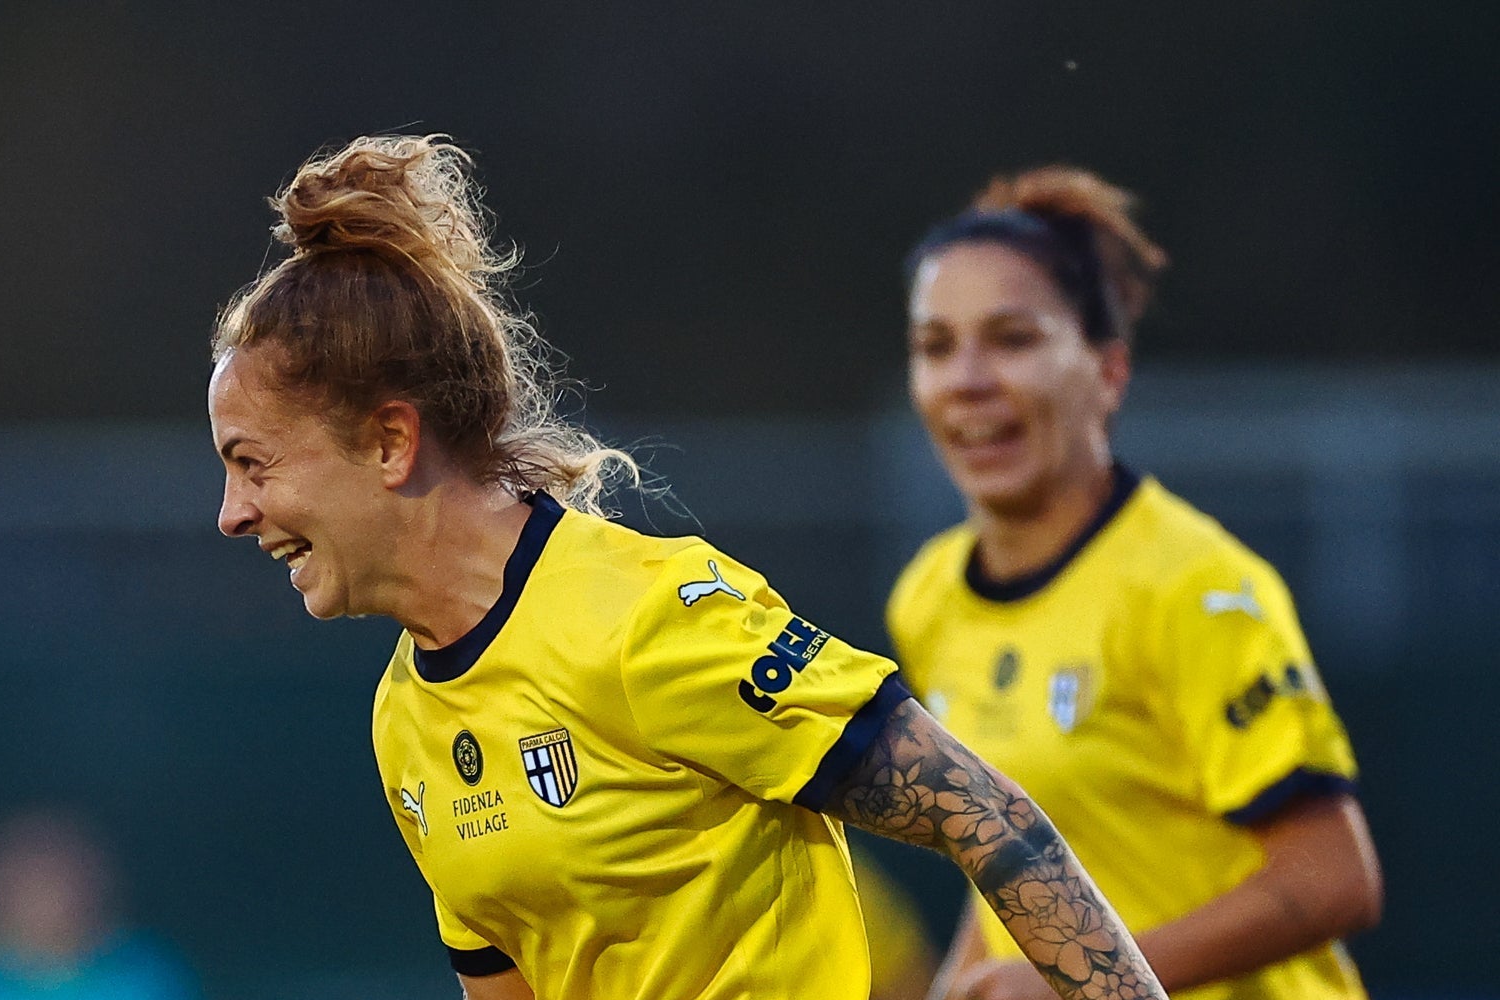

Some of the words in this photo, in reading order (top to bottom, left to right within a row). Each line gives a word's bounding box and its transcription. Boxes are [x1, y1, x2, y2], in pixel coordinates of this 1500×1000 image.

[521, 737, 543, 750] PARMA
[544, 731, 567, 744] CALCIO
[452, 789, 504, 817] FIDENZA
[456, 813, 509, 840] VILLAGE
